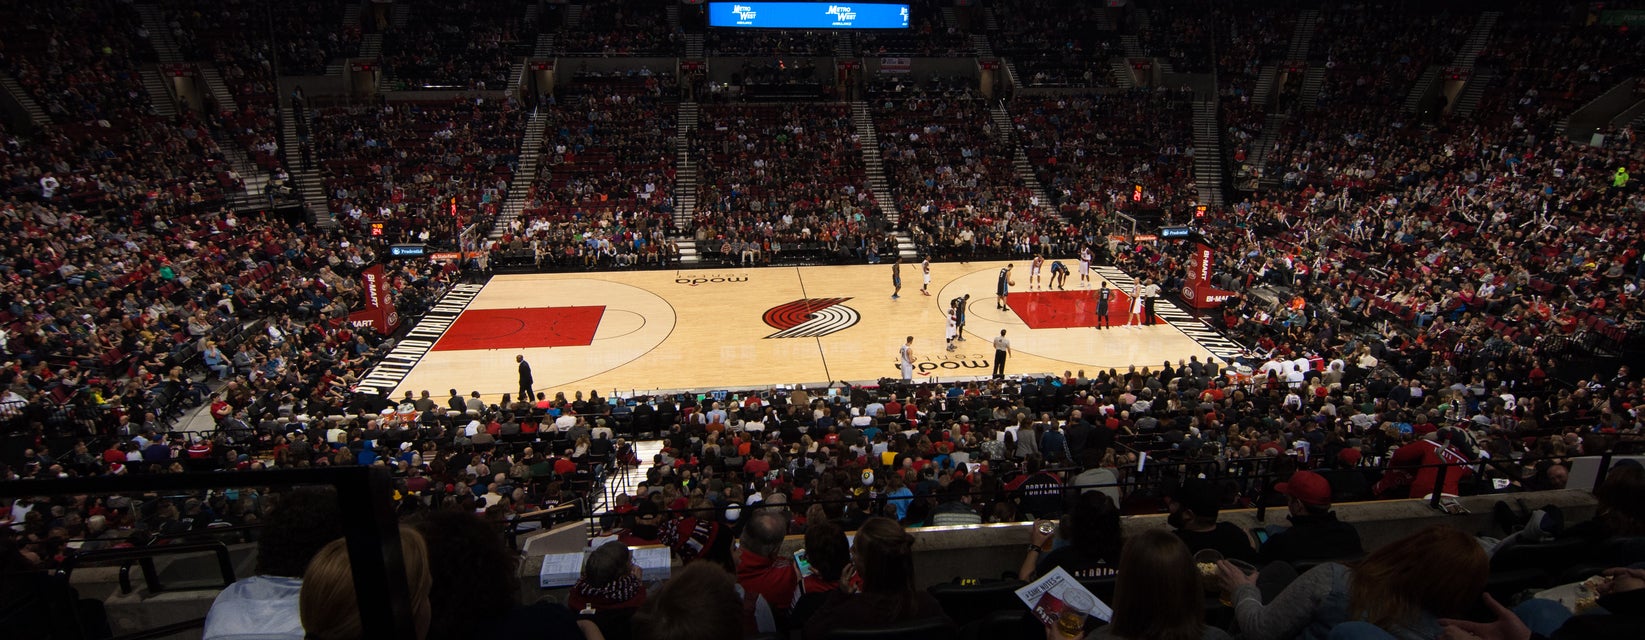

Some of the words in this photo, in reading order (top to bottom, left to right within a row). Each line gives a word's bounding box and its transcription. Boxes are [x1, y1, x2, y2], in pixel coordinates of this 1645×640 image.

[827, 5, 851, 14] METRO
[838, 13, 856, 21] WEST
[675, 277, 748, 285] moda
[368, 274, 378, 308] BI-MART
[354, 340, 433, 395] PORTLAND
[406, 315, 456, 337] TRAIL
[431, 283, 483, 312] BLAZERS
[1040, 577, 1057, 593] NOTES
